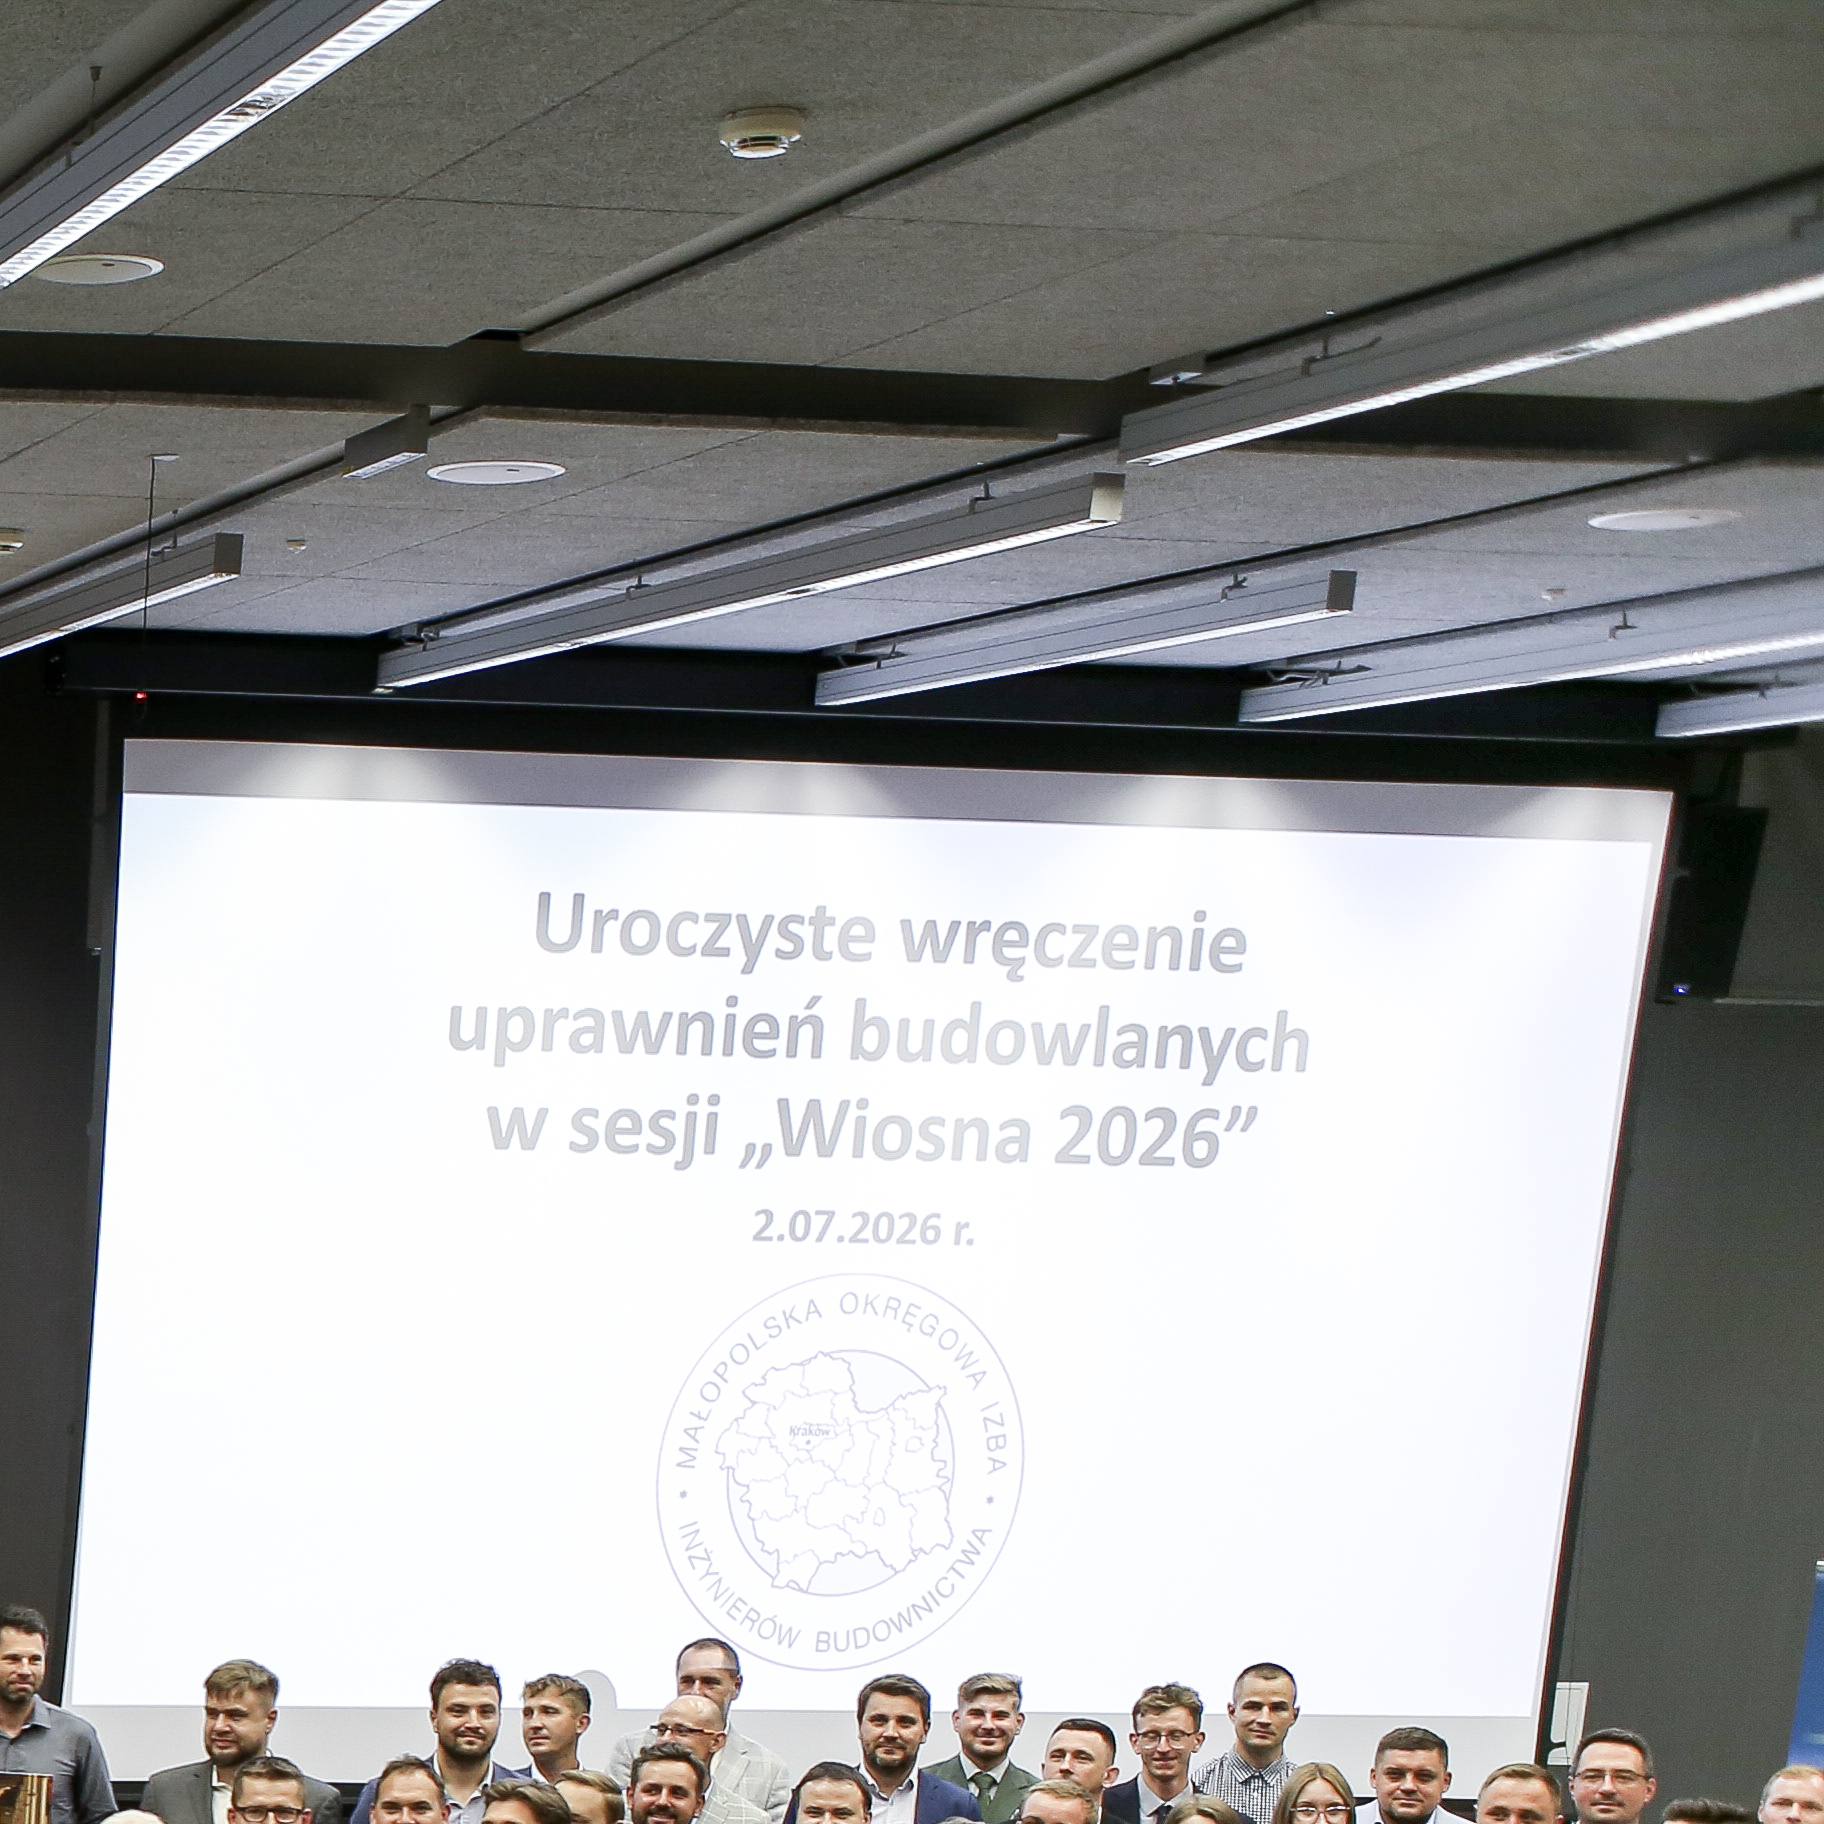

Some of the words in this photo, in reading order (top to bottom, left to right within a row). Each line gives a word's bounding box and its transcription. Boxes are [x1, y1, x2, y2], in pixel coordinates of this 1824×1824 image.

[536, 892, 876, 975] Uroczyste
[900, 910, 1247, 982] wręczenie
[448, 995, 825, 1067] uprawnień
[850, 998, 1309, 1086] budowlanych
[486, 1105, 549, 1150] w
[568, 1093, 721, 1171] sesji
[738, 1098, 1031, 1170] „Wiosna
[1054, 1105, 1258, 1169] 2026”
[752, 1208, 942, 1245] 2.07.2026
[953, 1220, 975, 1247] r.
[676, 1298, 823, 1469] MAŁOPOLSKA
[839, 1292, 987, 1390] OKRĘGOWA
[980, 1401, 1007, 1475] IZBA
[678, 1521, 801, 1649] INŻYNIERÓW
[815, 1528, 993, 1653] BUDOWNICTWA
